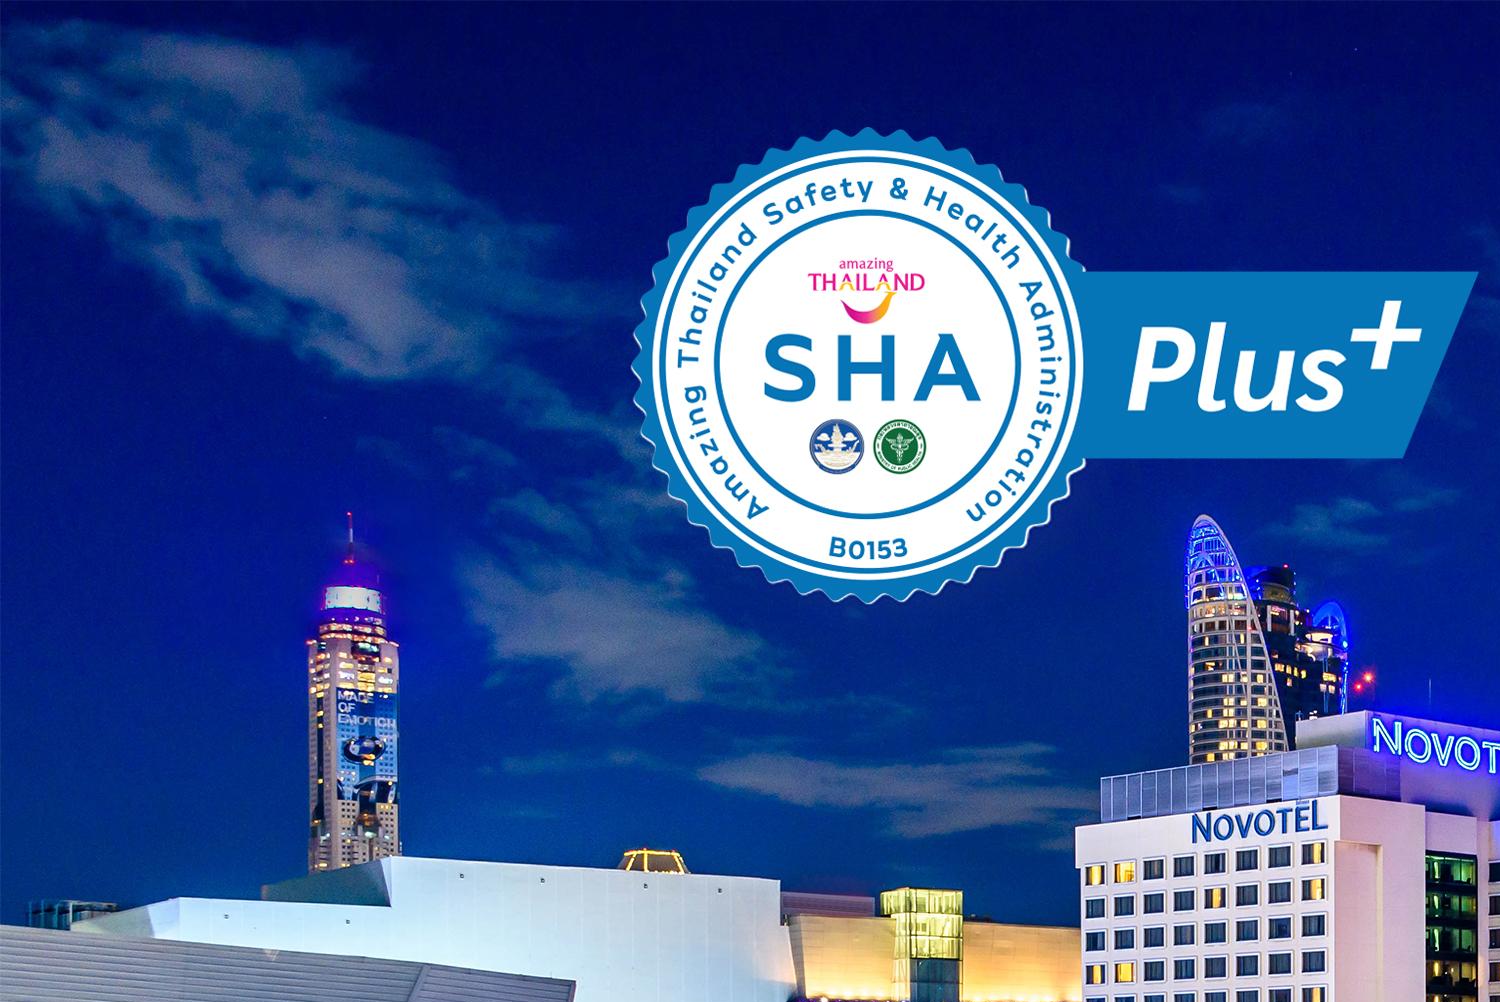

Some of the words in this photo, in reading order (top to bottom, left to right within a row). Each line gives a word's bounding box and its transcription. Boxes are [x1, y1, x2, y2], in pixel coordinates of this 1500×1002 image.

[338, 690, 374, 704] MADE
[338, 702, 356, 713] OF
[1191, 799, 1329, 844] NOVOTEL
